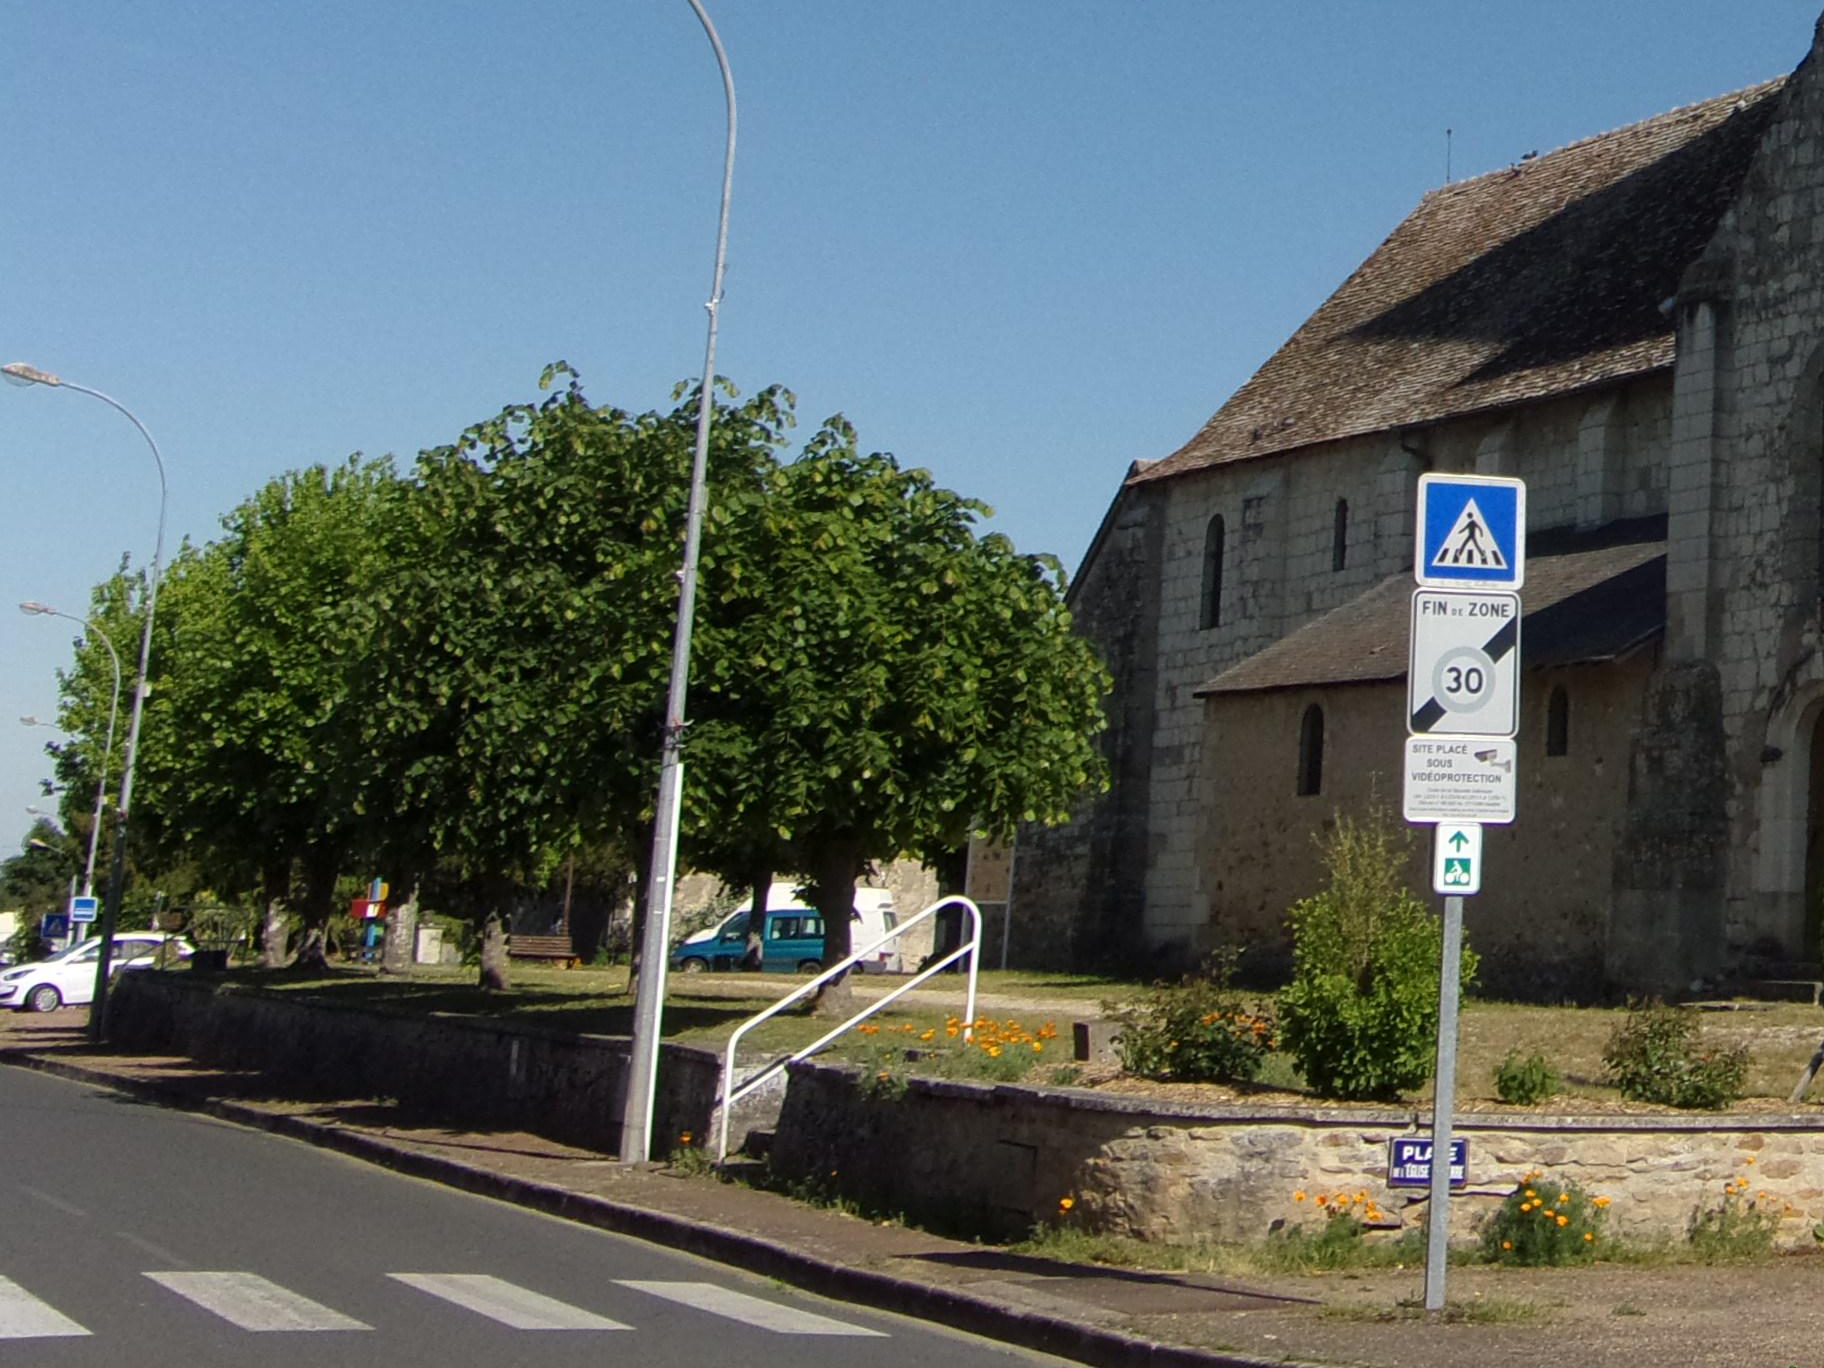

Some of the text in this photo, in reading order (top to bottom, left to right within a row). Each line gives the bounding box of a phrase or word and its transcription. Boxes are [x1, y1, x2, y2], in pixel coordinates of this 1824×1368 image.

[1422, 600, 1448, 615] FIN
[1468, 602, 1510, 618] ZONE
[1445, 666, 1483, 694] 30
[1412, 744, 1468, 755] SITE PLACÉ
[1426, 759, 1453, 768] SOUS
[1411, 771, 1502, 783] VIDÉOPROTECTION
[1402, 1145, 1458, 1162] PLAE
